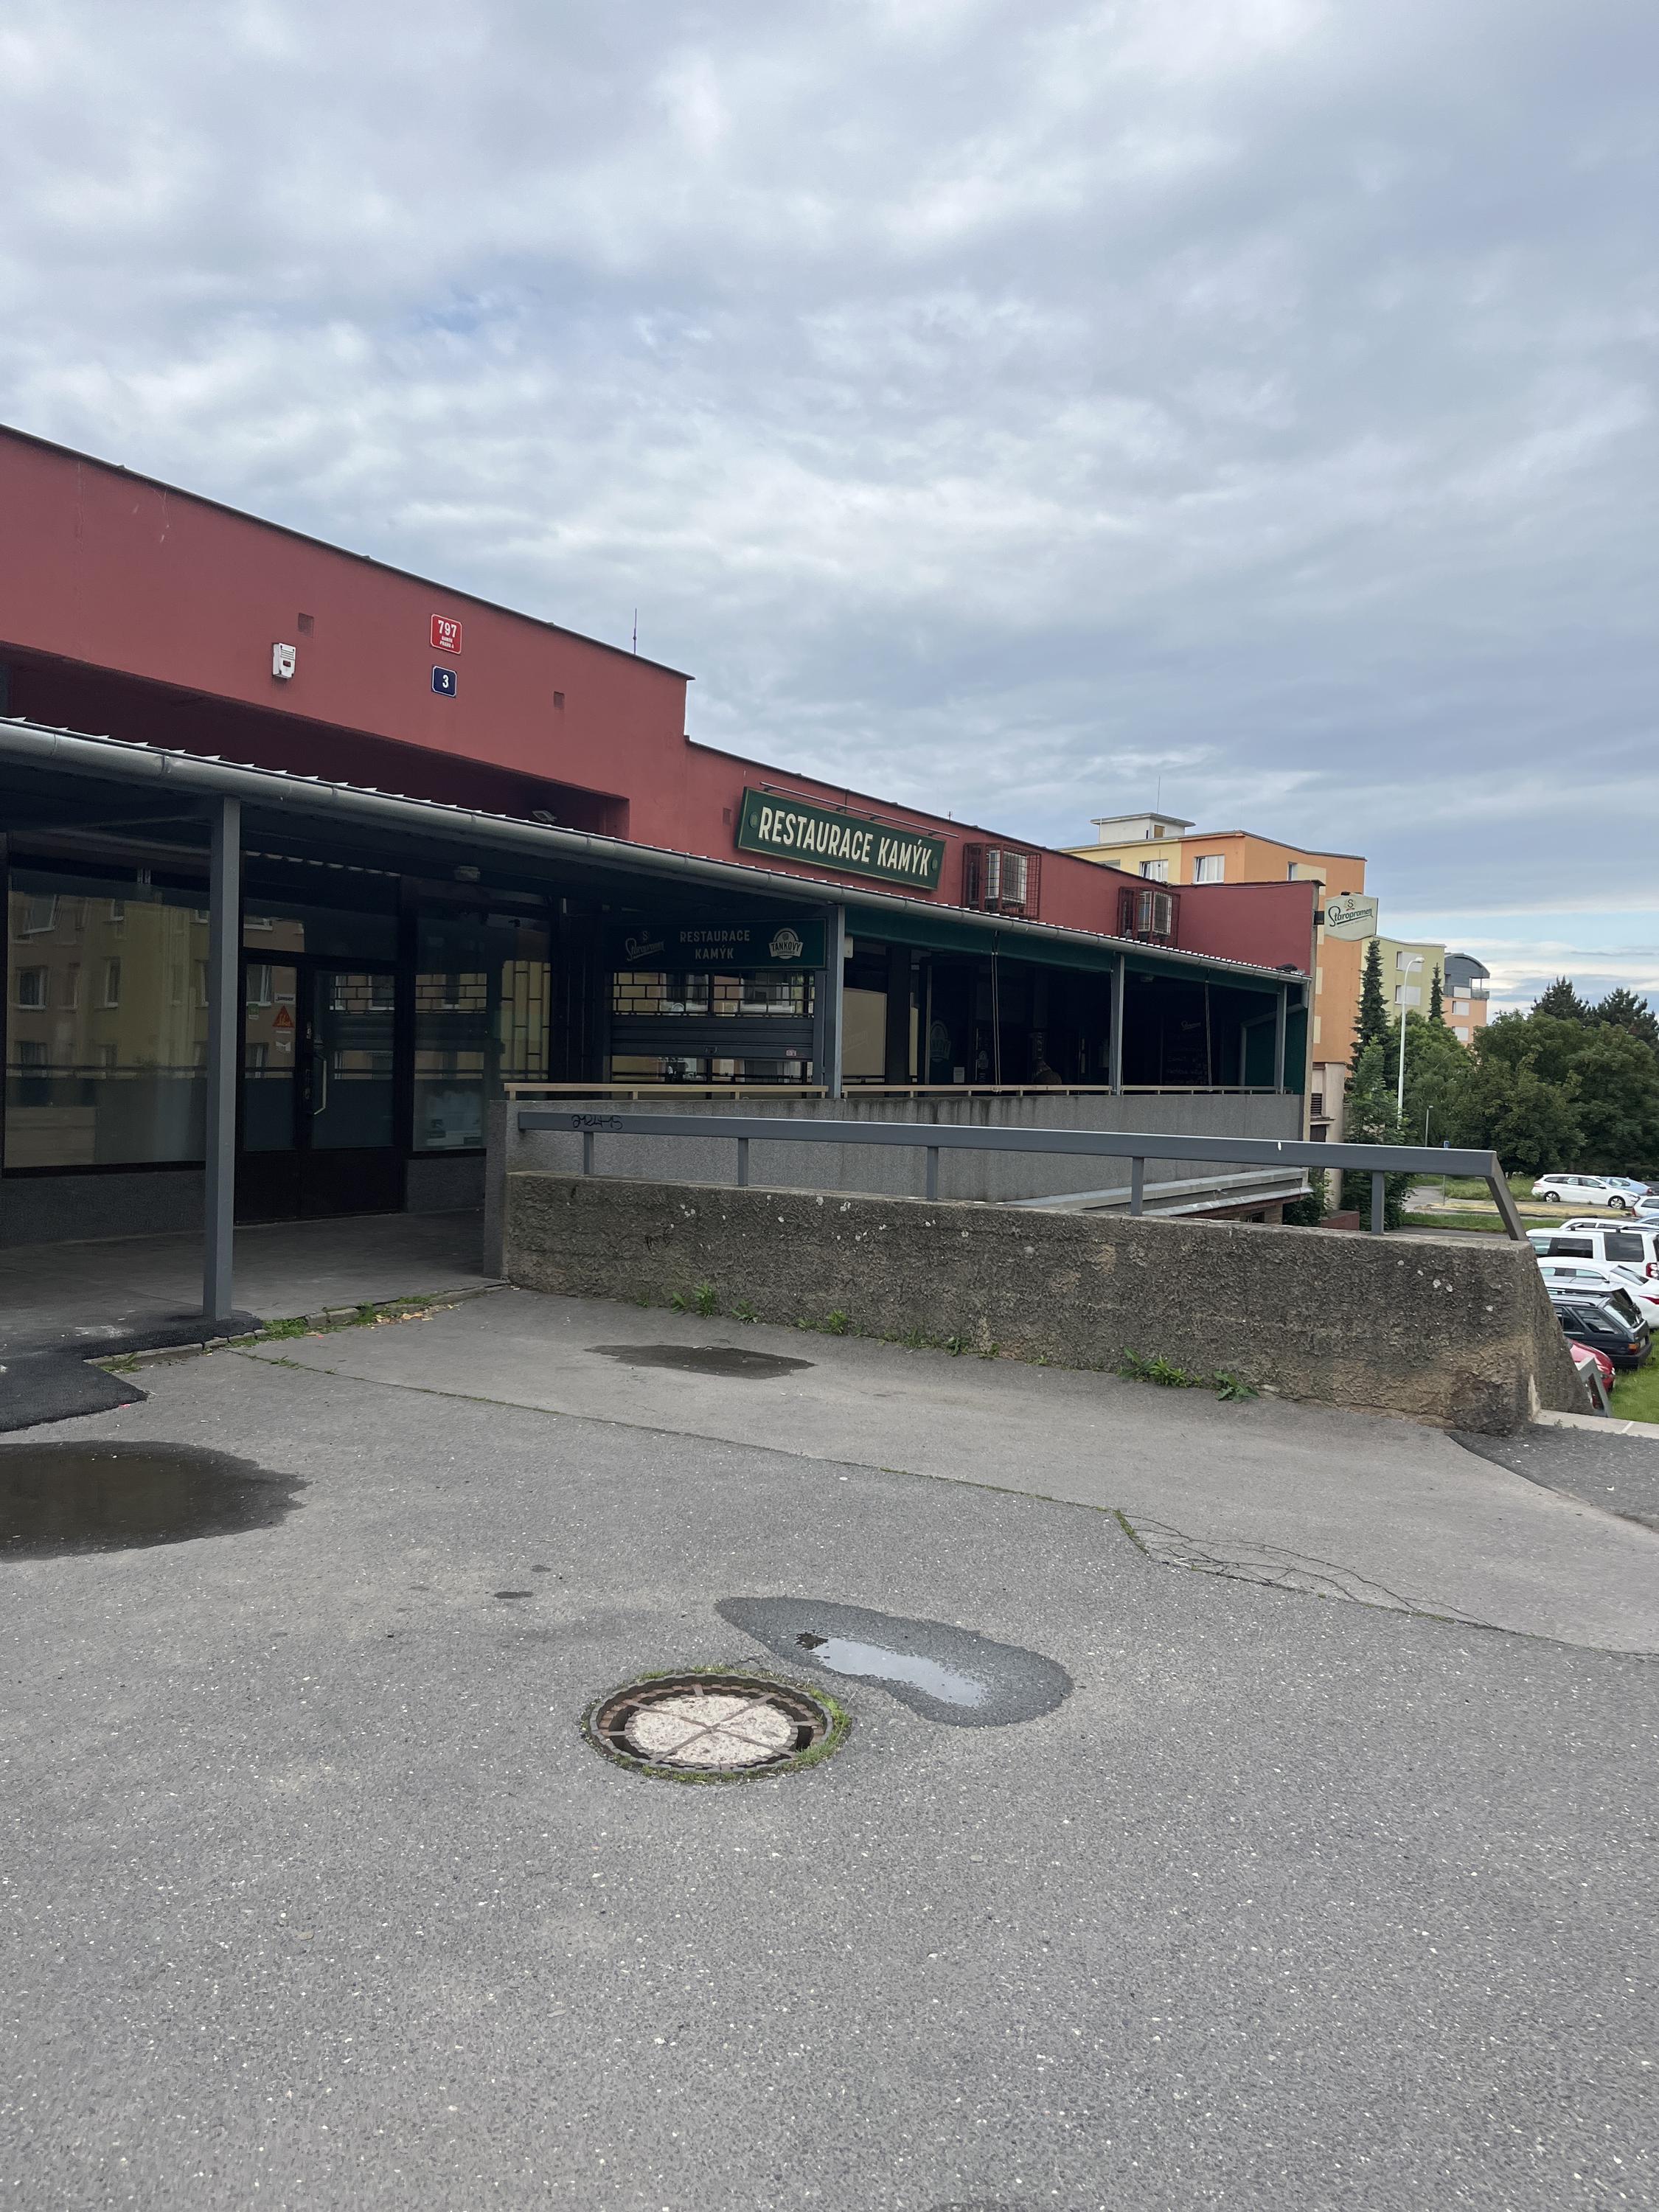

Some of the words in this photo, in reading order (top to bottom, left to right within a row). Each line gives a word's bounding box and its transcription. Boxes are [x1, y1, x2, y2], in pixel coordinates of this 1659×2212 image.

[438, 619, 457, 639] 797
[442, 674, 449, 688] 3
[758, 806, 873, 863] RESTAURACE
[877, 838, 932, 876] KAMÝK
[1328, 905, 1373, 927] Staropramen
[679, 930, 751, 943] RESTAURACE
[695, 945, 734, 959] KAMÝK
